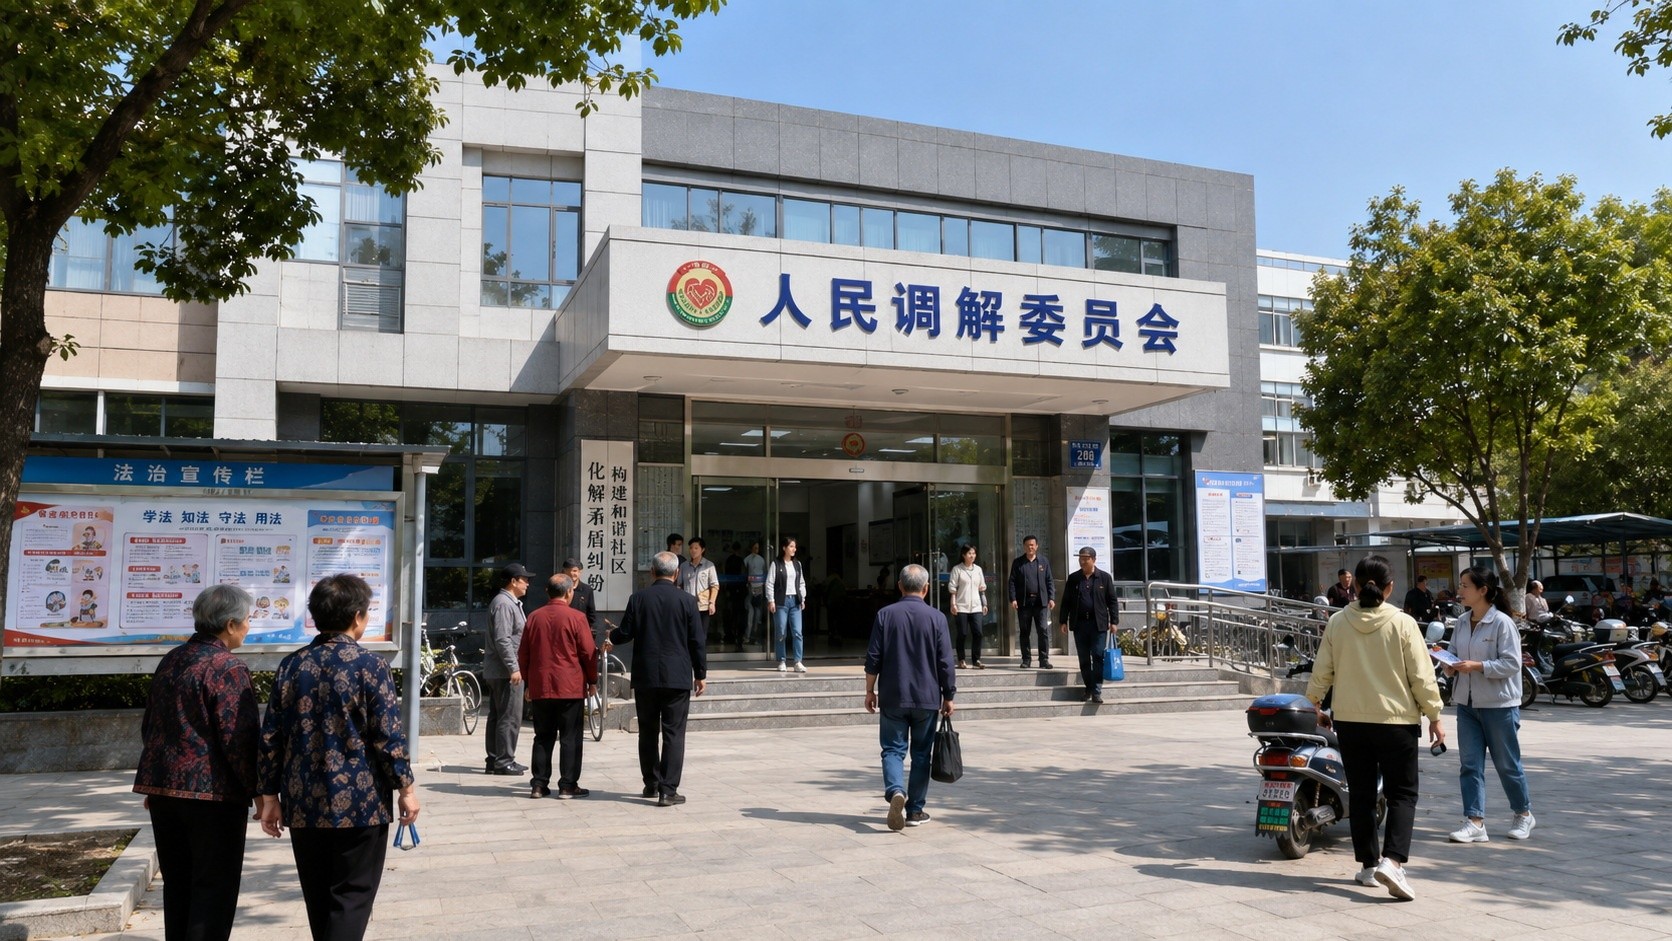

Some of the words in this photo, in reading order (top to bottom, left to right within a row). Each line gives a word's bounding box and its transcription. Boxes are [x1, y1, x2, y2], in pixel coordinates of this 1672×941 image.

[760, 273, 1180, 354] 人民调解委员会
[113, 463, 265, 485] 法治宣传栏
[142, 510, 172, 524] 学法
[181, 510, 210, 524] 知法
[218, 511, 246, 525] 守法
[254, 512, 282, 525] 用法
[587, 462, 605, 592] 化解矛盾纠纷
[611, 466, 627, 574] 构建和谐社区
